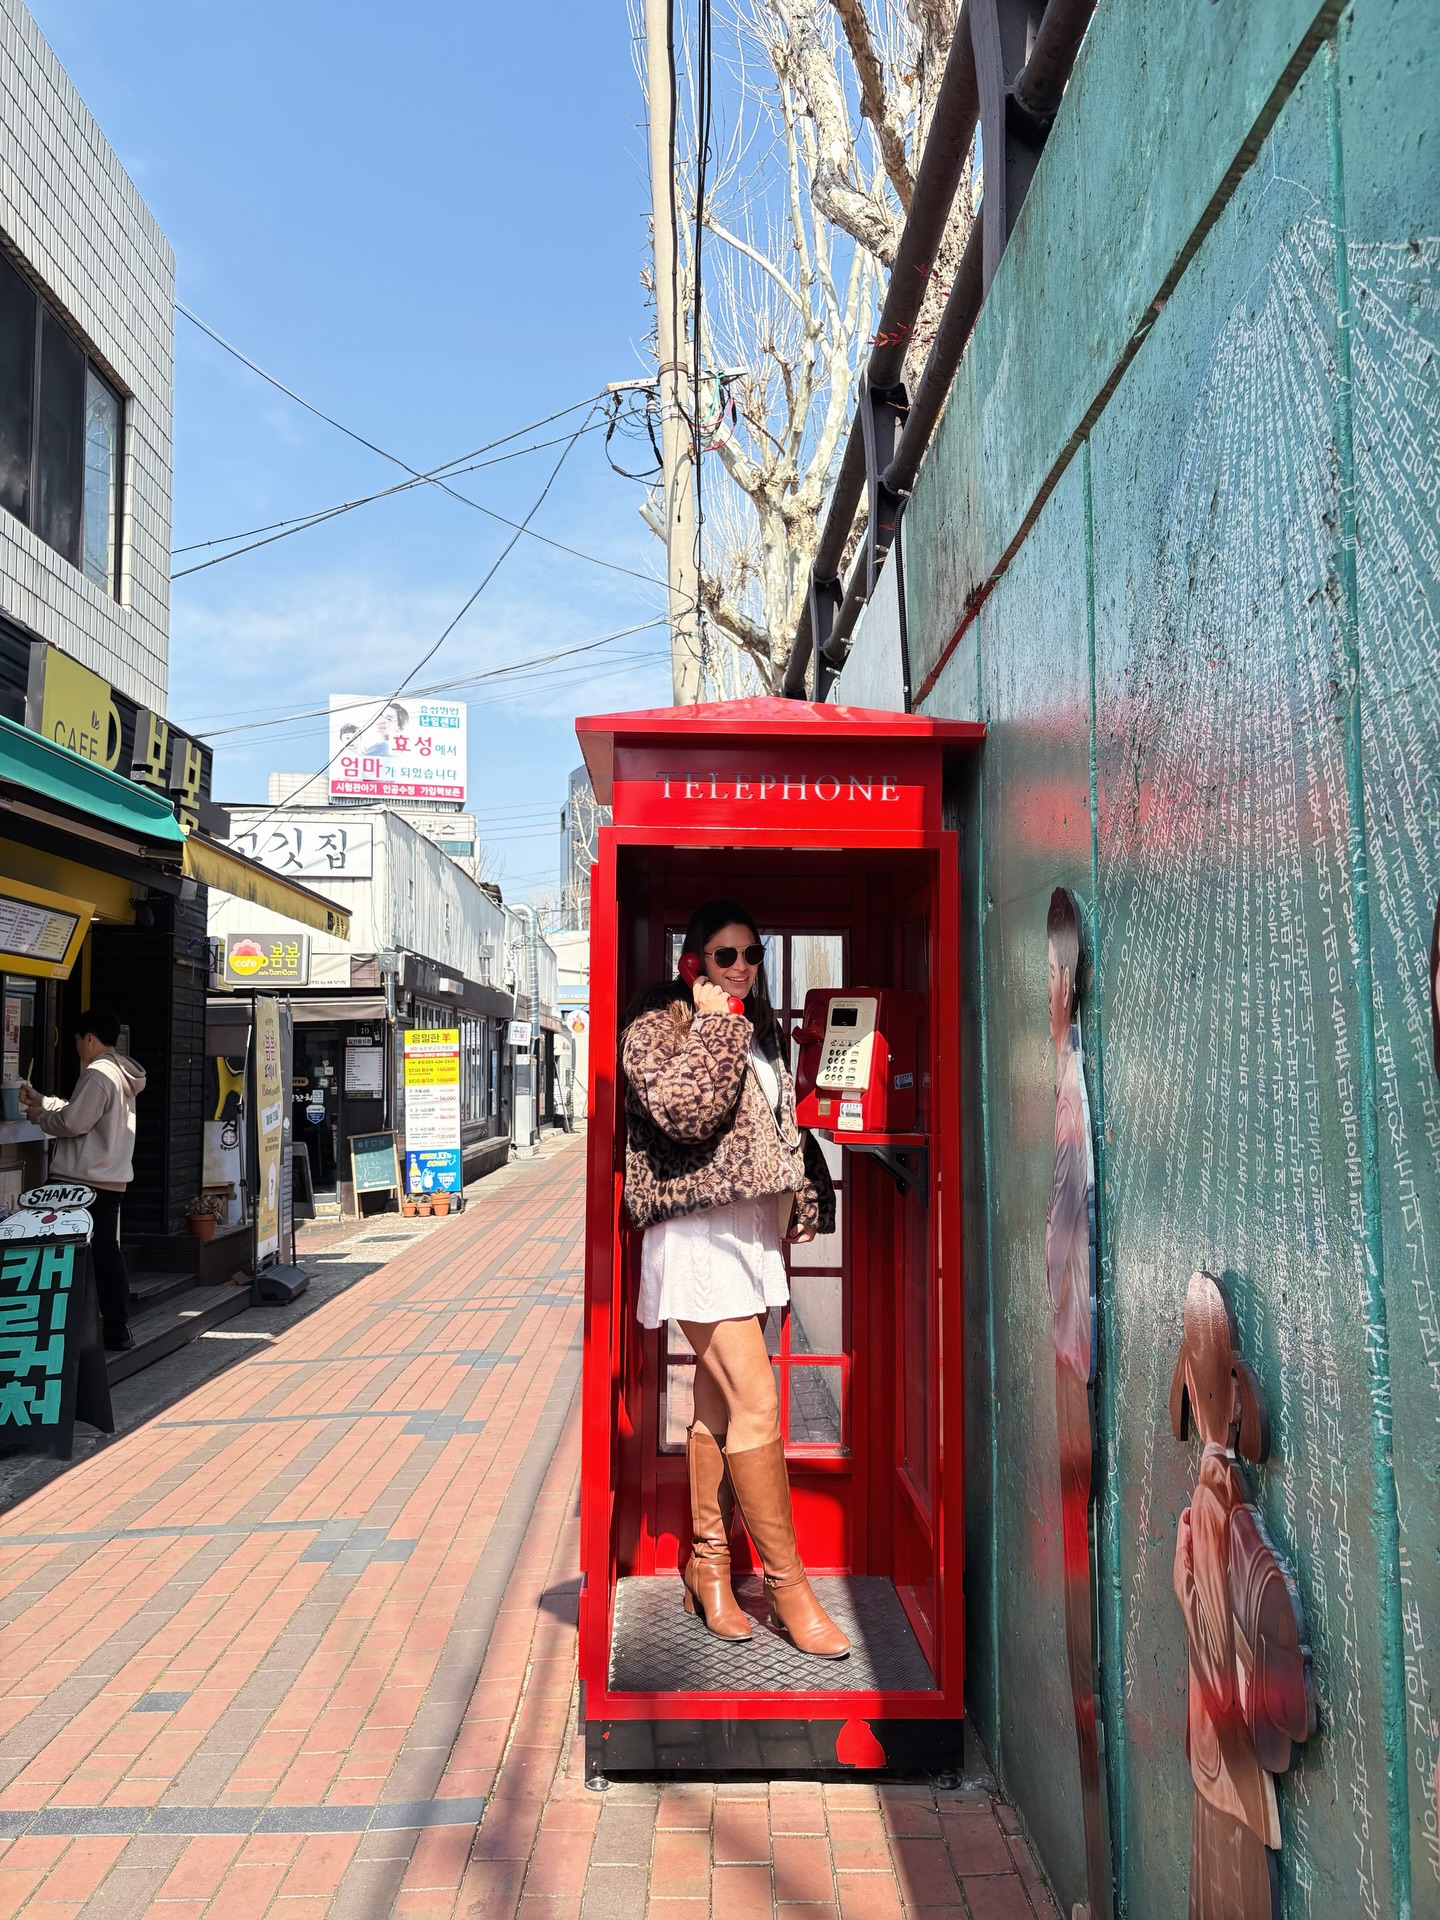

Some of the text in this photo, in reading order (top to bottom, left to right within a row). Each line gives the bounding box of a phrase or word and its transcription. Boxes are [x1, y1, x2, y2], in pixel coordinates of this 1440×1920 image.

[419, 705, 459, 716] 효성병원
[420, 716, 459, 728] 난임센터
[54, 720, 99, 760] CAFE
[392, 735, 457, 757] 효성에서
[341, 757, 457, 780] 엄마가 되었습니다
[336, 784, 378, 793] 시험관아기
[382, 785, 415, 795] 인공수정
[655, 771, 900, 801] TELEPHONE
[235, 959, 257, 967] cafe
[270, 941, 301, 968] 봄봄
[0, 1244, 76, 1427] 캐리커처
